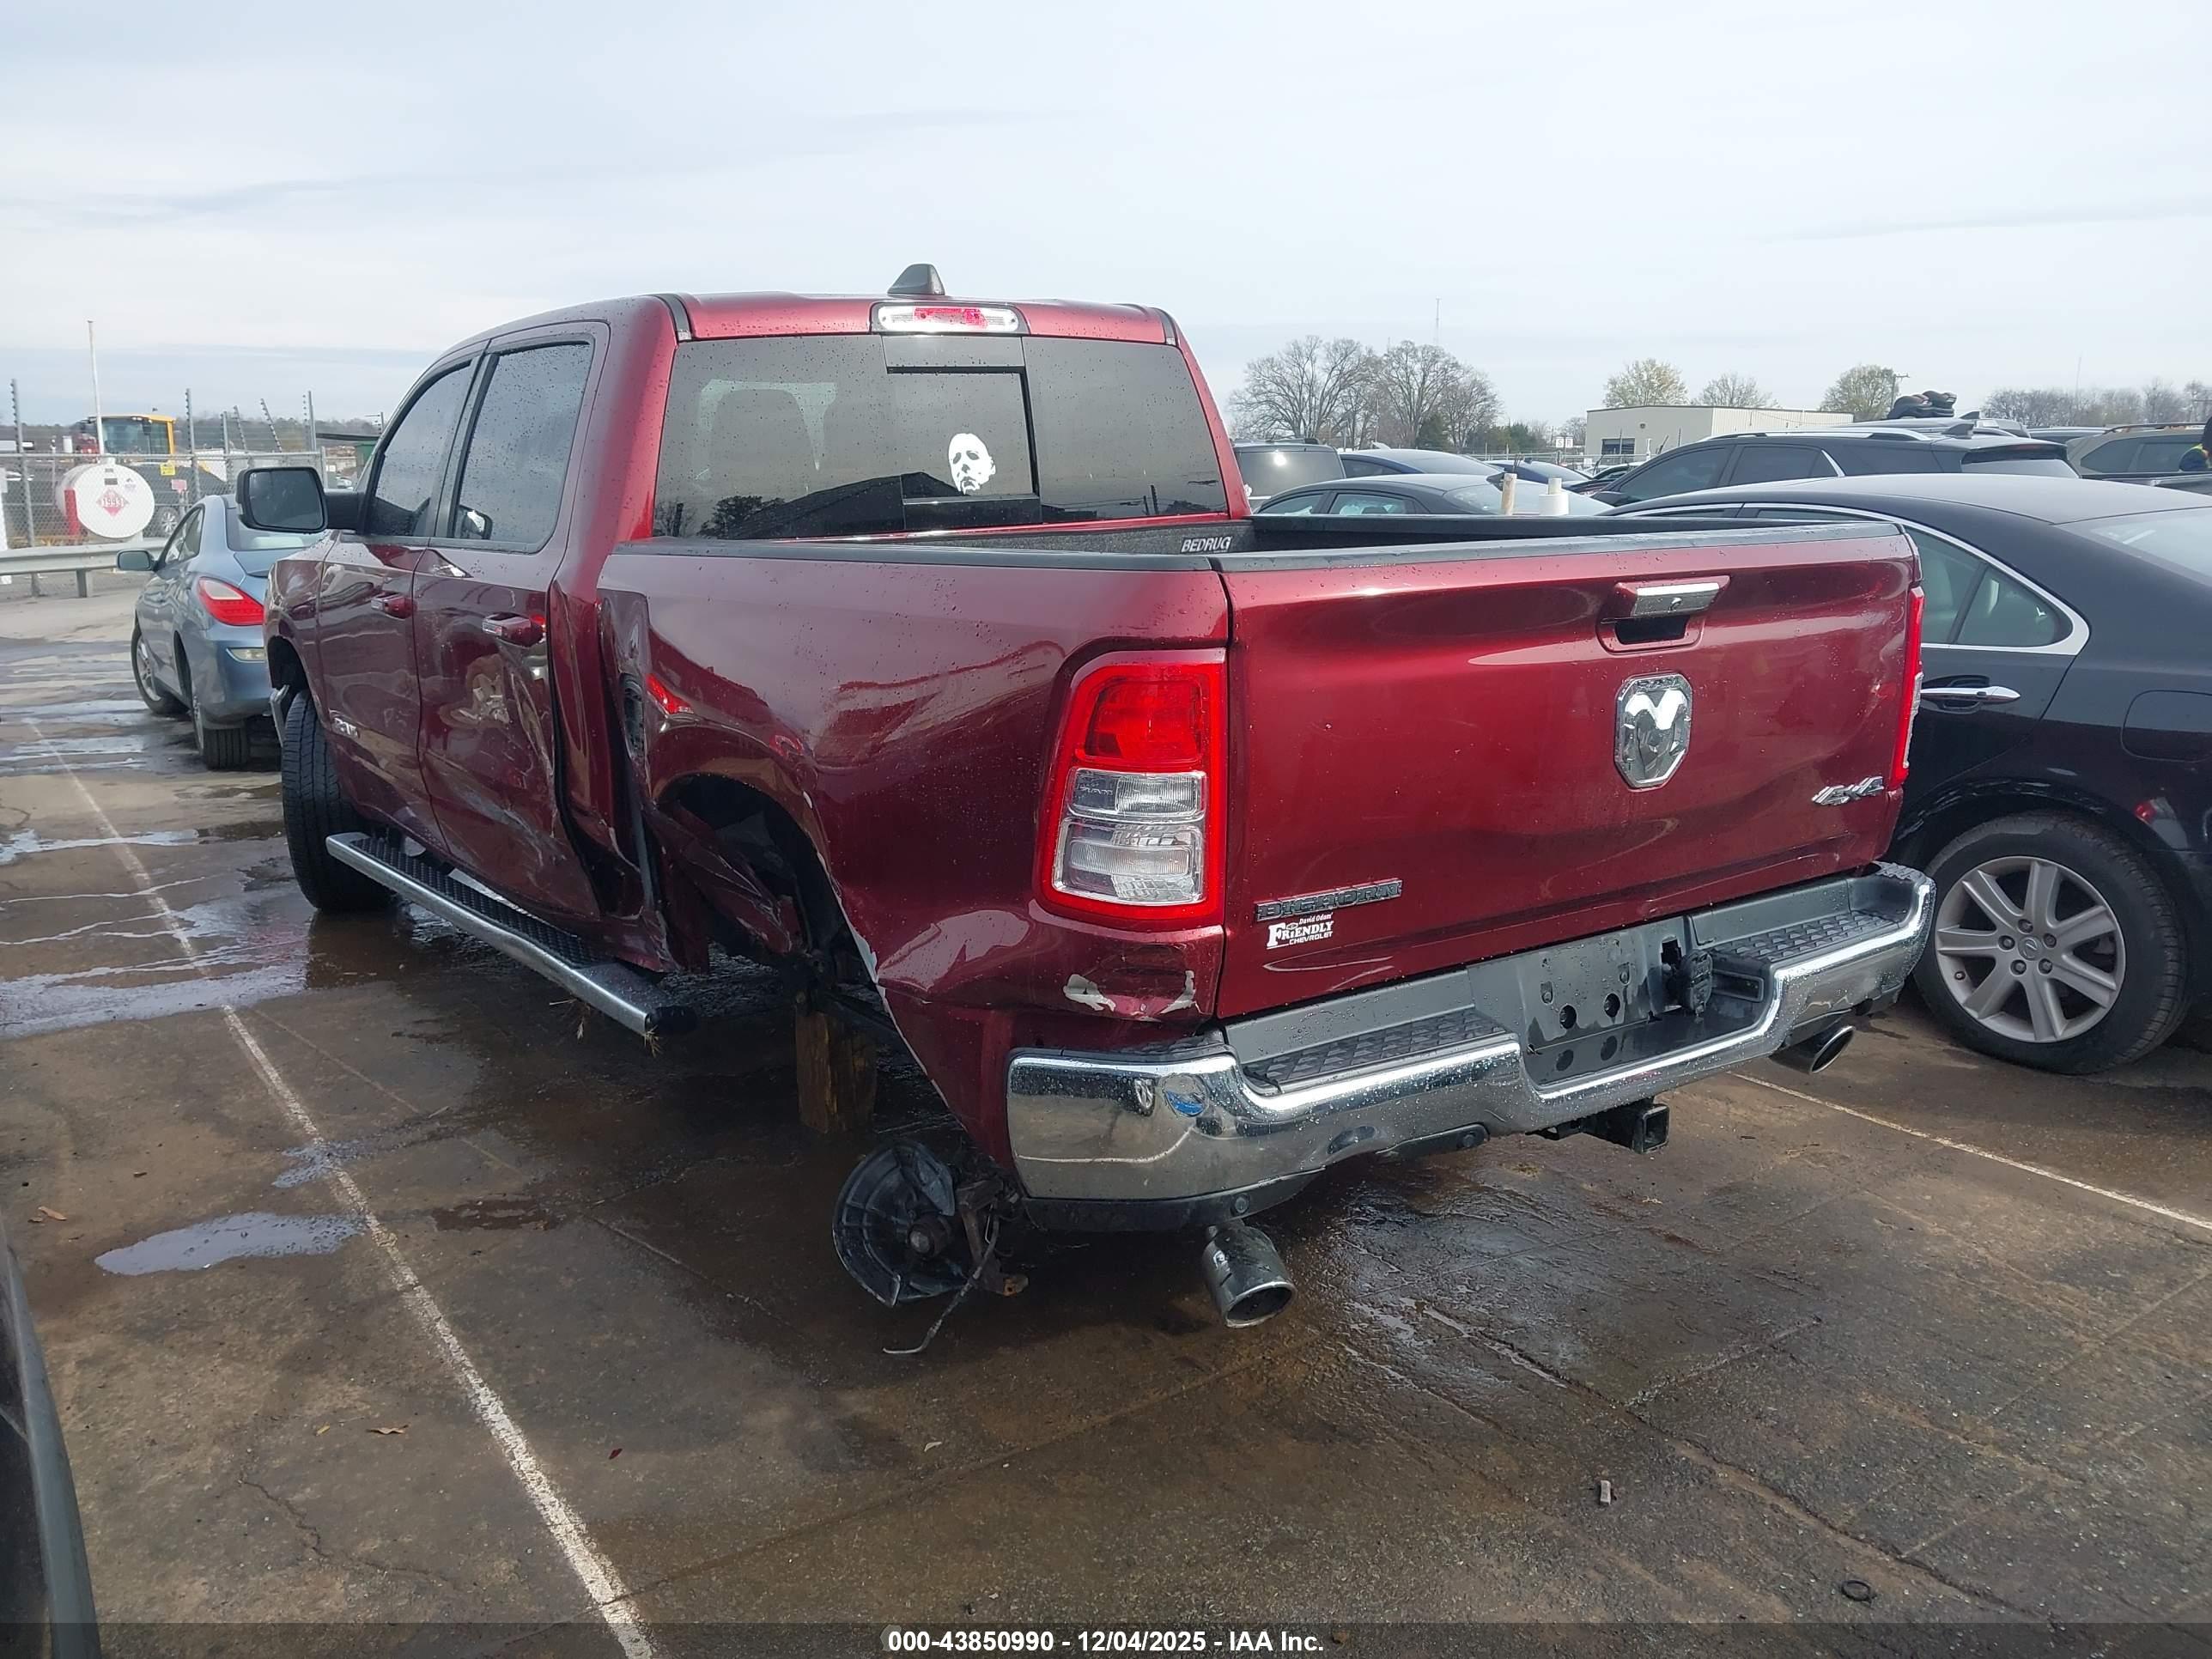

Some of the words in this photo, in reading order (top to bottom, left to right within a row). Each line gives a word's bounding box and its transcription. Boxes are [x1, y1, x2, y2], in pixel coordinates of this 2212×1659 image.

[1181, 536, 1232, 553] BEDRUG
[1299, 915, 1316, 925] David
[1289, 931, 1334, 945] CHEVROLET
